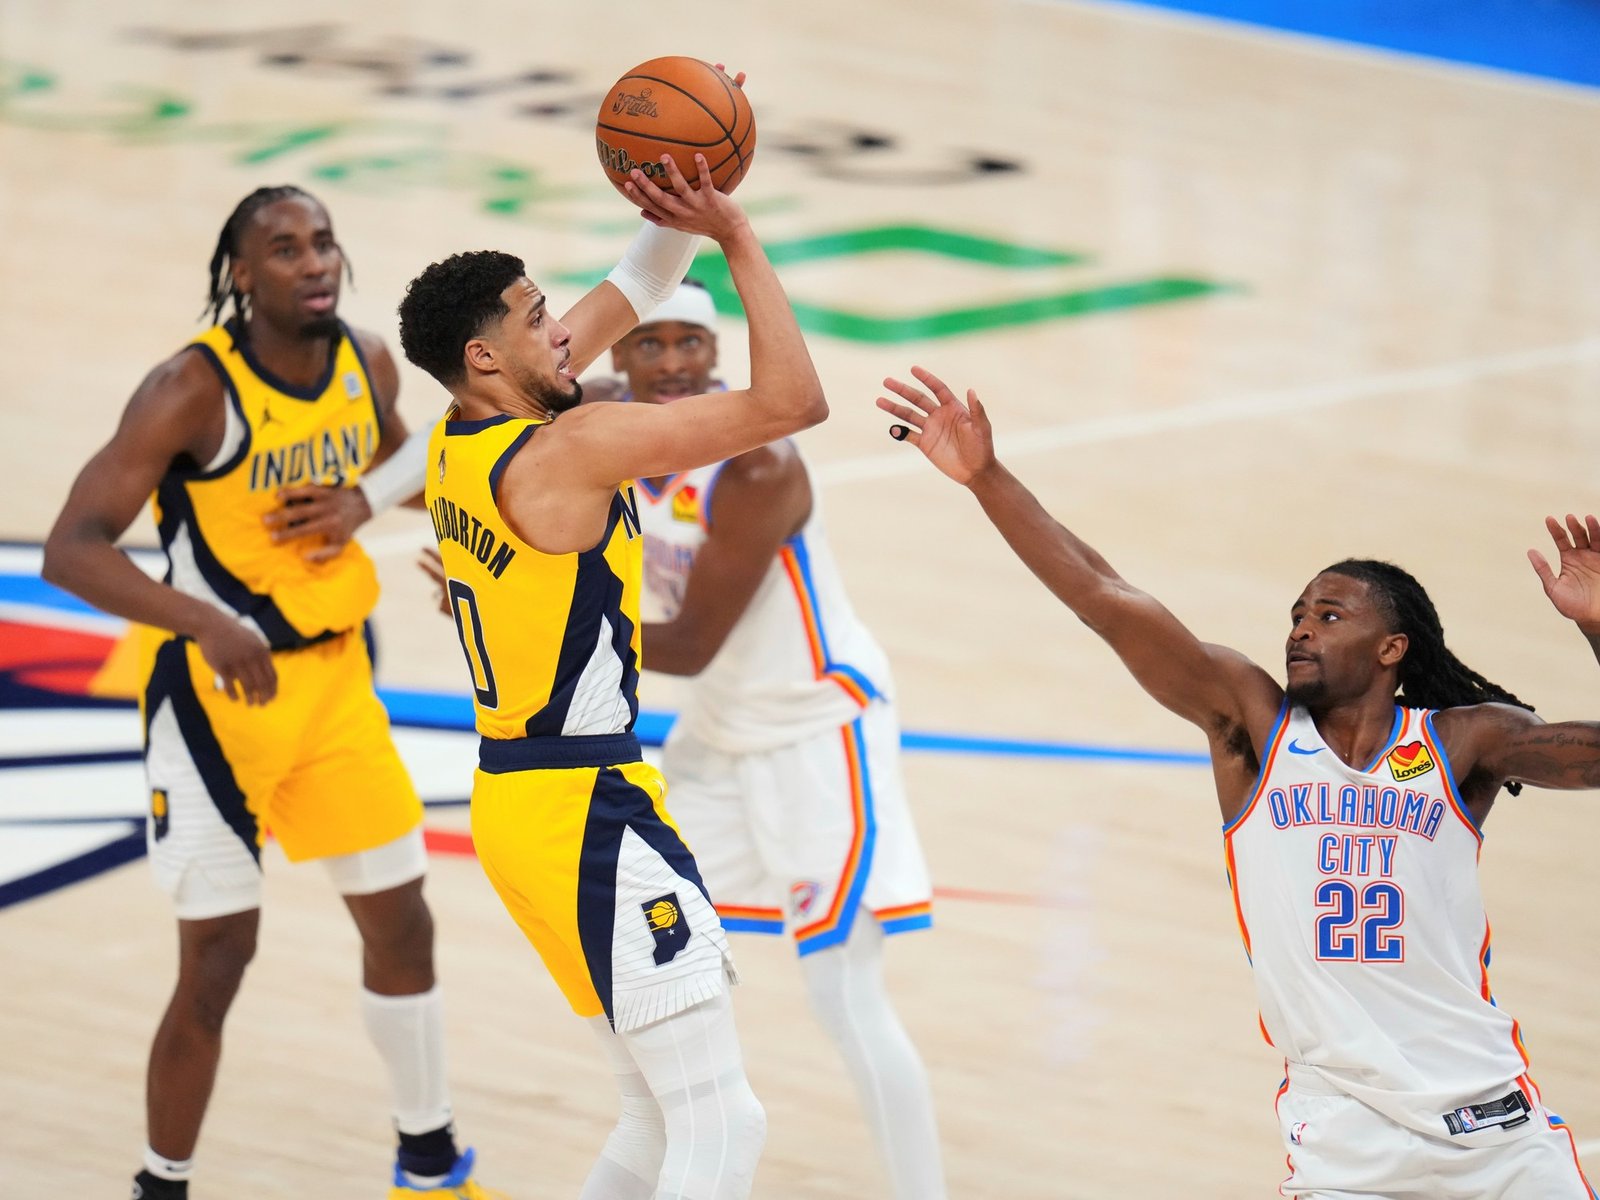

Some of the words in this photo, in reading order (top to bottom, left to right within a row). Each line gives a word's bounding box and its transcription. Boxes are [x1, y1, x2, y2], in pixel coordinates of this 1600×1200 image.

[448, 578, 499, 711] 0
[1267, 783, 1447, 842] OKLAHOMA
[1317, 832, 1398, 877] CITY
[1314, 878, 1405, 963] 22
